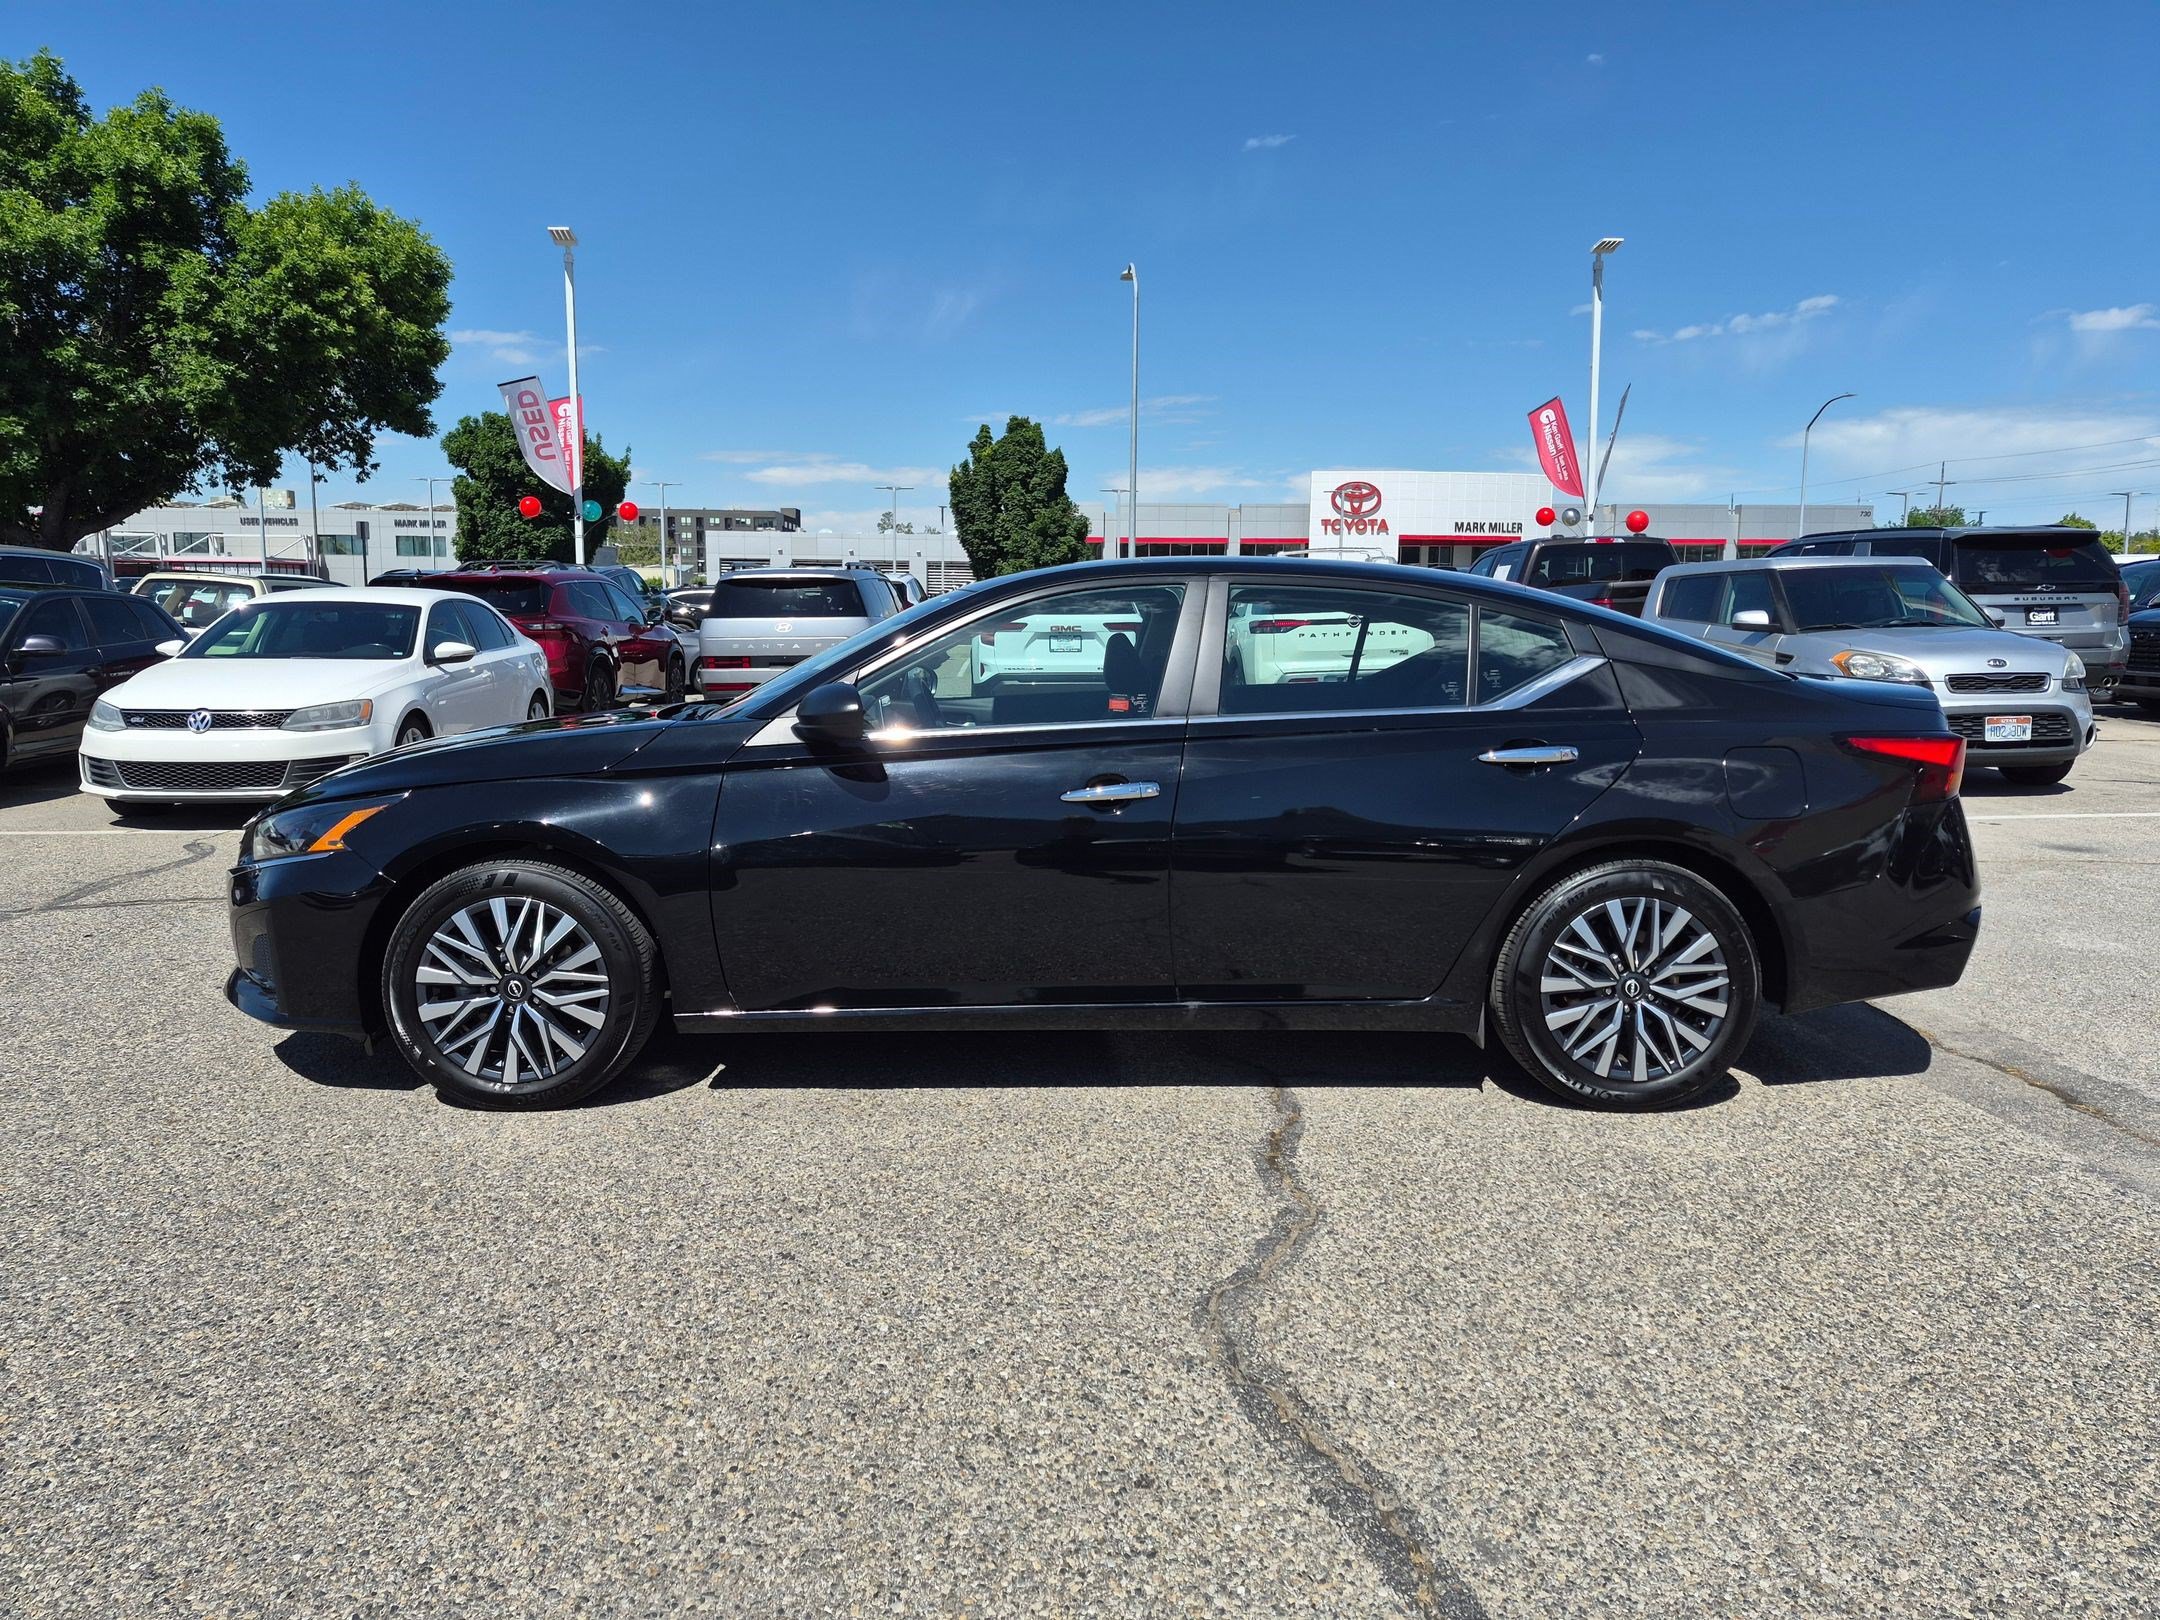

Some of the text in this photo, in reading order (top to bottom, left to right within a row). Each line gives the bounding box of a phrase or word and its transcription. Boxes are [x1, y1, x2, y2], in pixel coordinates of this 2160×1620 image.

[1550, 420, 1559, 434] Ken
[1542, 424, 1557, 457] Nissan
[1554, 433, 1564, 450] Garff
[1860, 510, 1872, 518] 730
[240, 517, 299, 527] USED VEHICLES
[394, 519, 447, 528] MARK MILER
[1321, 519, 1389, 536] TOYOTA
[1454, 521, 1523, 534] MARK MILLER
[1298, 630, 1409, 639] PATHFNDER
[1560, 1073, 1625, 1101] SOLUS
